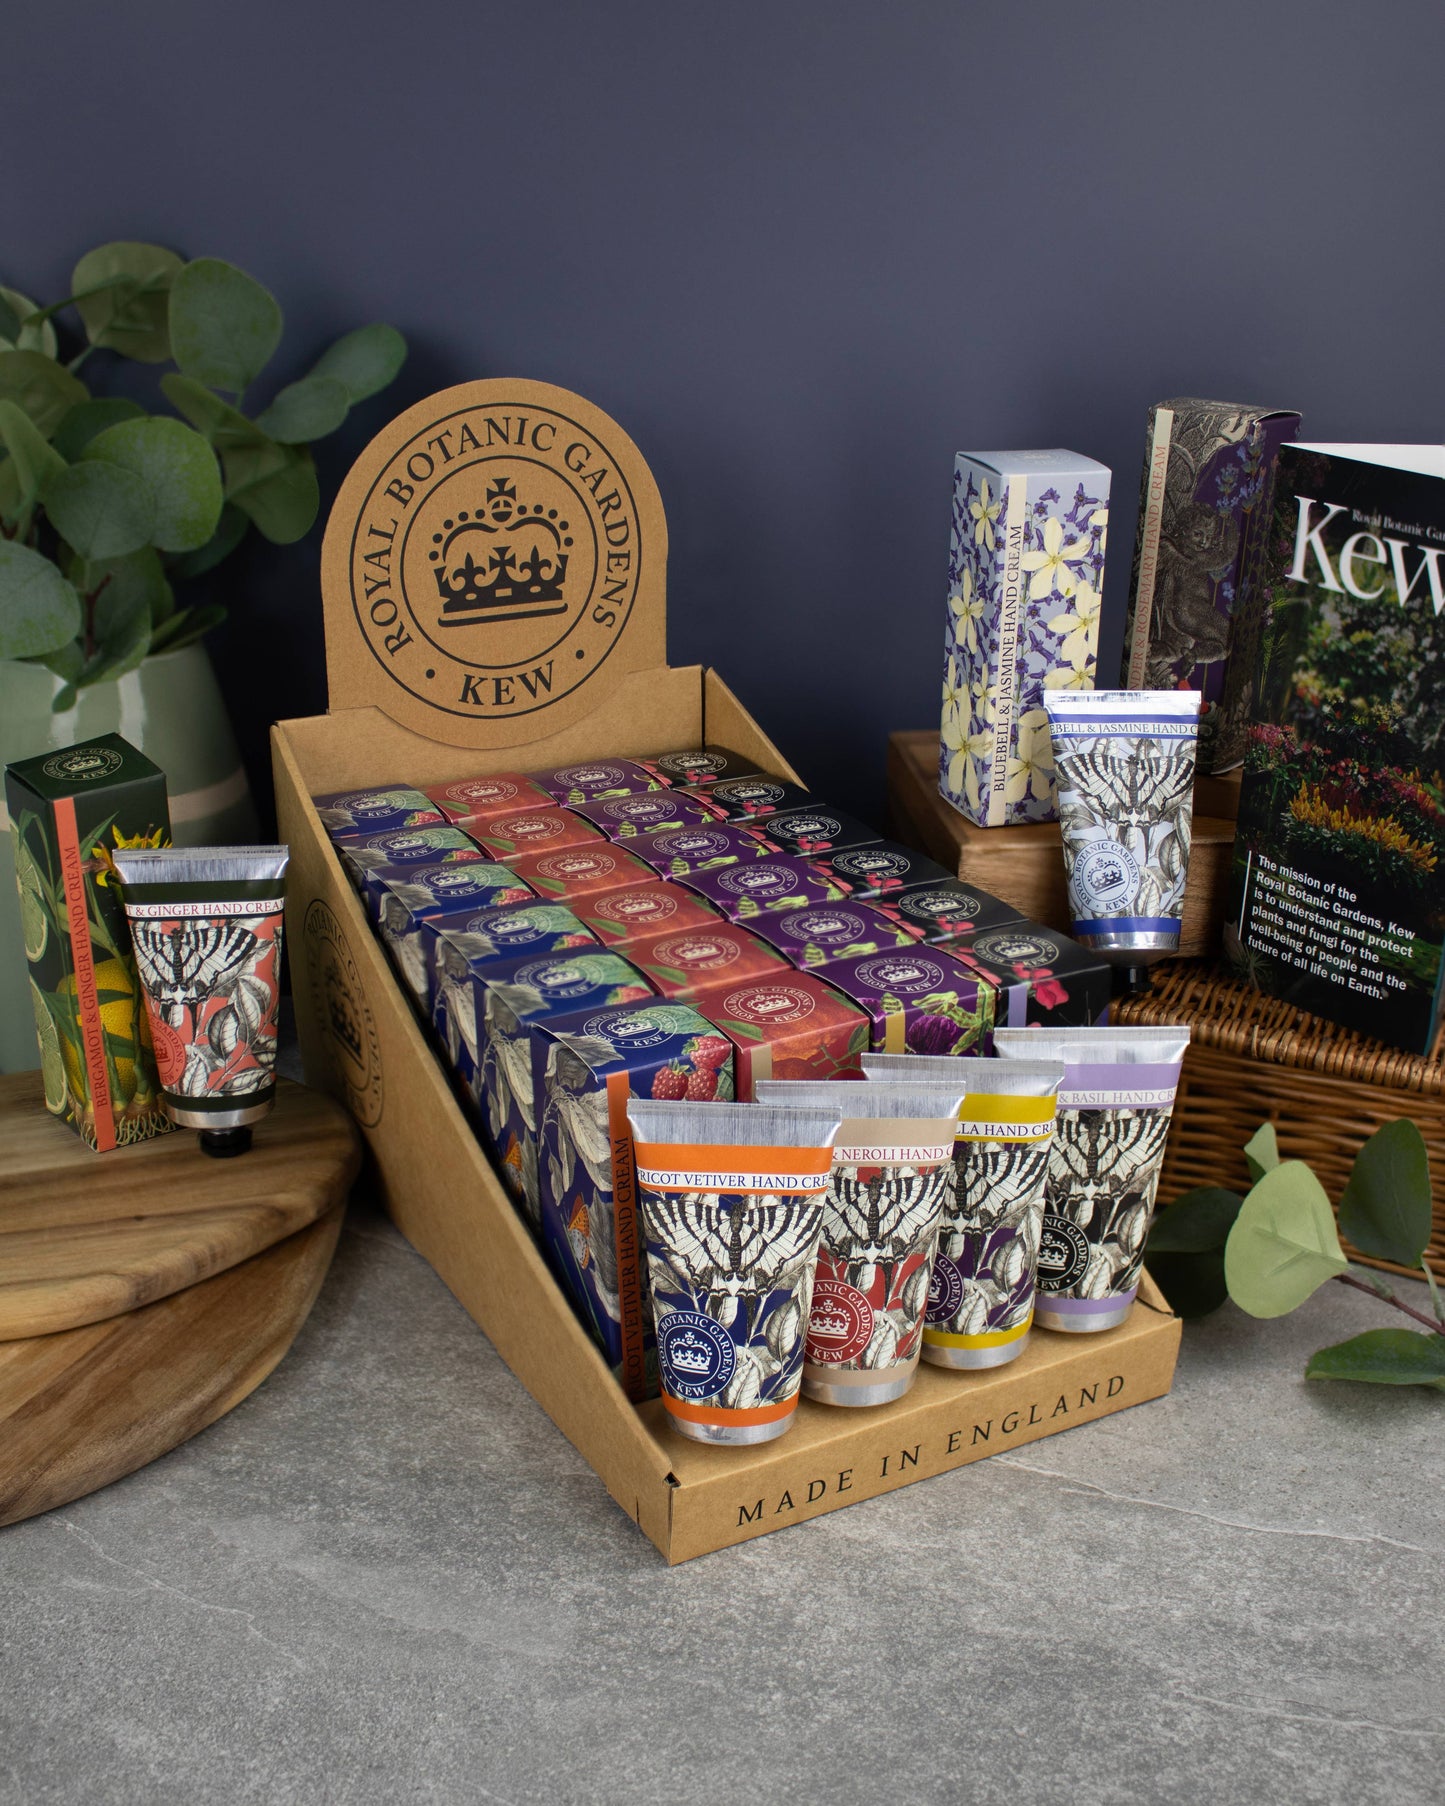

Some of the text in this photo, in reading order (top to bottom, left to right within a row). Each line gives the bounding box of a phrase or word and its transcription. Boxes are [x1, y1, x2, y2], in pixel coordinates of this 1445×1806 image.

[1150, 445, 1167, 502] CREAM
[363, 416, 631, 657] ROYAL BOTANIC GARDENS
[1146, 503, 1159, 552] HAND
[1352, 508, 1382, 527] Royal
[1383, 515, 1425, 537] Botanic
[1285, 495, 1445, 617] Kew
[1137, 552, 1155, 637] ROSEMARY
[994, 524, 1022, 793] BLUEBELL & JASMINE HAND CREAM
[1134, 638, 1146, 648] &
[458, 659, 554, 706] KEW
[1087, 724, 1096, 733] &
[1099, 723, 1150, 734] JASMINE
[1152, 724, 1188, 734] HAND
[761, 886, 785, 895] KEW
[877, 868, 899, 877] KEW
[1075, 842, 1139, 905] ROYAL BOTANIC GARDENS
[1258, 854, 1357, 903] The mission of the
[135, 907, 145, 917] &
[147, 904, 199, 917] GINGER
[202, 903, 243, 915] HAND
[638, 913, 664, 922] KEW
[946, 911, 969, 919] KEW
[1105, 894, 1129, 911] KEW
[1256, 871, 1416, 941] Royal Botanic Gardens, Kew
[509, 933, 537, 943] KEW
[827, 932, 853, 942] KEW
[1251, 904, 1380, 964] plants and fungi for the
[1254, 886, 1414, 958] is to understand and protect
[699, 959, 725, 968] KEW
[1023, 956, 1048, 966] KEW
[1248, 935, 1383, 1000] future of all life on Earth.
[1250, 920, 1407, 991] well-being of people and the
[64, 846, 107, 1108] BERGAMOT & GINGER HAND CREAM
[560, 985, 588, 997] KEW
[905, 981, 932, 992] KEW
[774, 1011, 802, 1022] KEW
[156, 1021, 183, 1064] GARDENS
[633, 1034, 663, 1047] KEW
[1058, 1093, 1069, 1103] &
[1072, 1092, 1109, 1104] BASIL
[1112, 1091, 1155, 1103] HAND
[984, 1124, 1029, 1137] HAND
[616, 1138, 631, 1205] CREAM
[842, 1148, 895, 1161] NEROLI
[900, 1148, 944, 1161] HAND
[684, 1173, 746, 1187] VETIVER
[751, 1175, 798, 1189] HAND
[618, 1206, 635, 1260] HAND
[1067, 1226, 1088, 1276] GARDENS
[938, 1258, 961, 1310] GARDENS
[1038, 1279, 1061, 1291] EW
[622, 1263, 638, 1342] VETIVER
[848, 1292, 871, 1345] GARDENS
[661, 1314, 708, 1332] BOTANIC
[709, 1325, 733, 1382] GARDENS
[813, 1348, 844, 1361] KEW
[676, 1382, 705, 1397] KEW
[735, 1374, 1126, 1527] MADE IN ENGLAND
